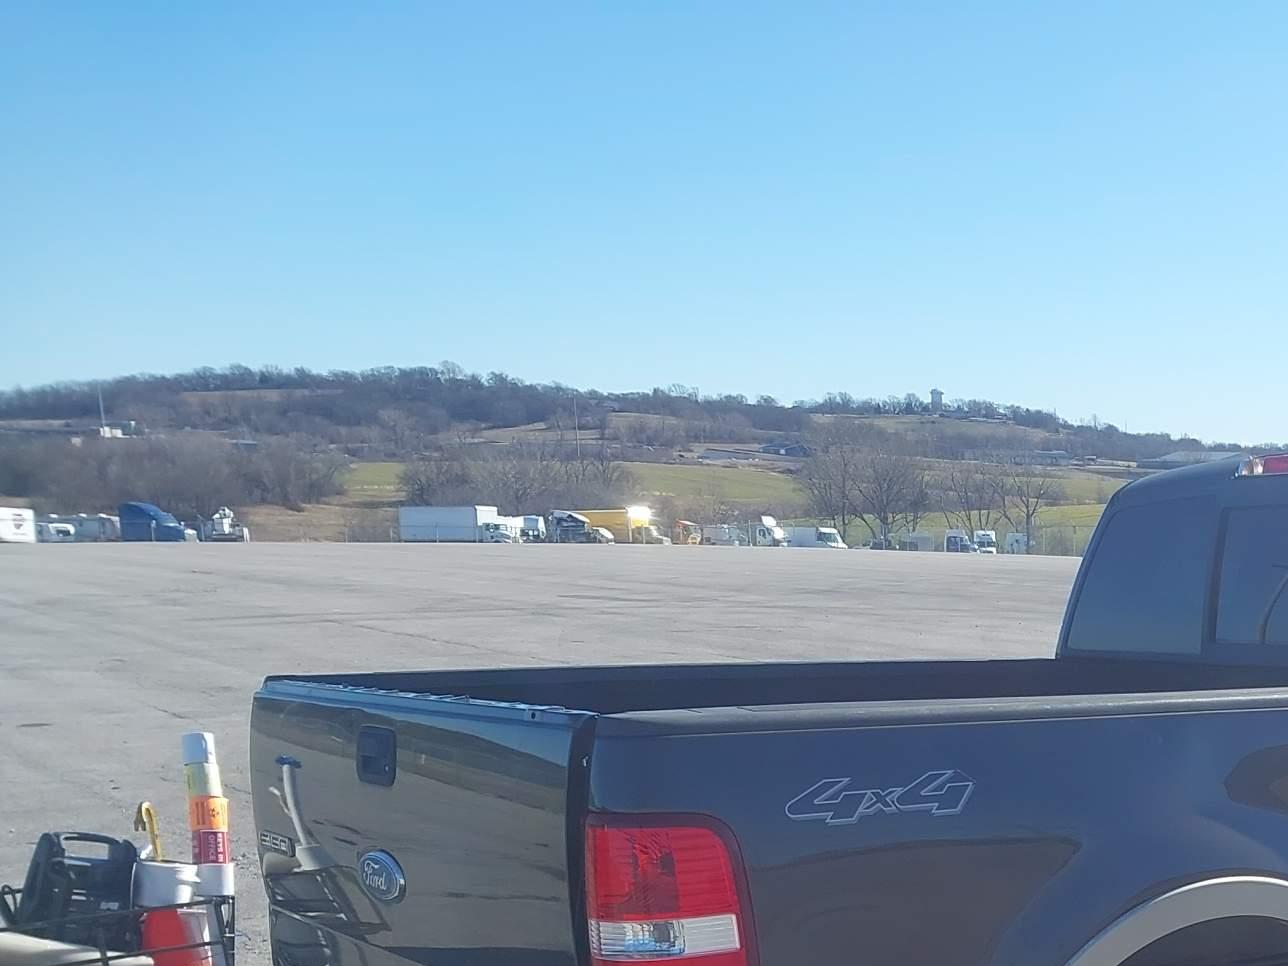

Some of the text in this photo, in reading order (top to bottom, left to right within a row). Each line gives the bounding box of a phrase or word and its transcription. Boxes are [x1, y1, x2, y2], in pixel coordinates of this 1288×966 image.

[785, 769, 977, 826] 4x4
[207, 834, 217, 861] OFFICE
[363, 860, 387, 891] Ford
